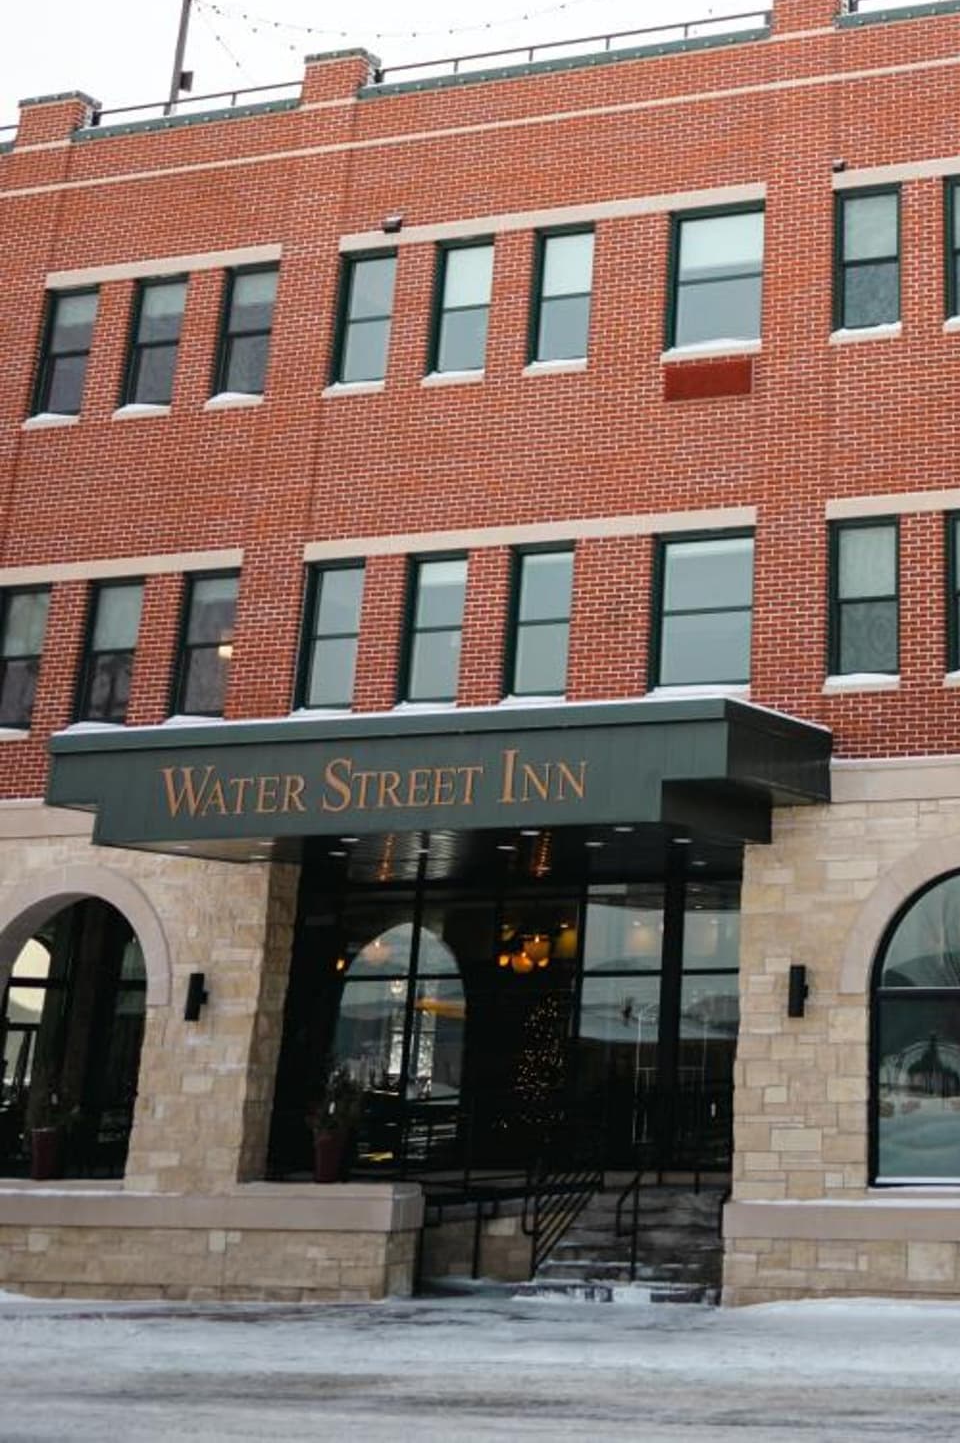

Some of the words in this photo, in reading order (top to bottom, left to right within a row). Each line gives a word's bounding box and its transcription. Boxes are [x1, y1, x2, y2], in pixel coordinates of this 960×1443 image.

[160, 764, 307, 819] WATER
[322, 757, 484, 813] STREET
[498, 748, 589, 805] INN
